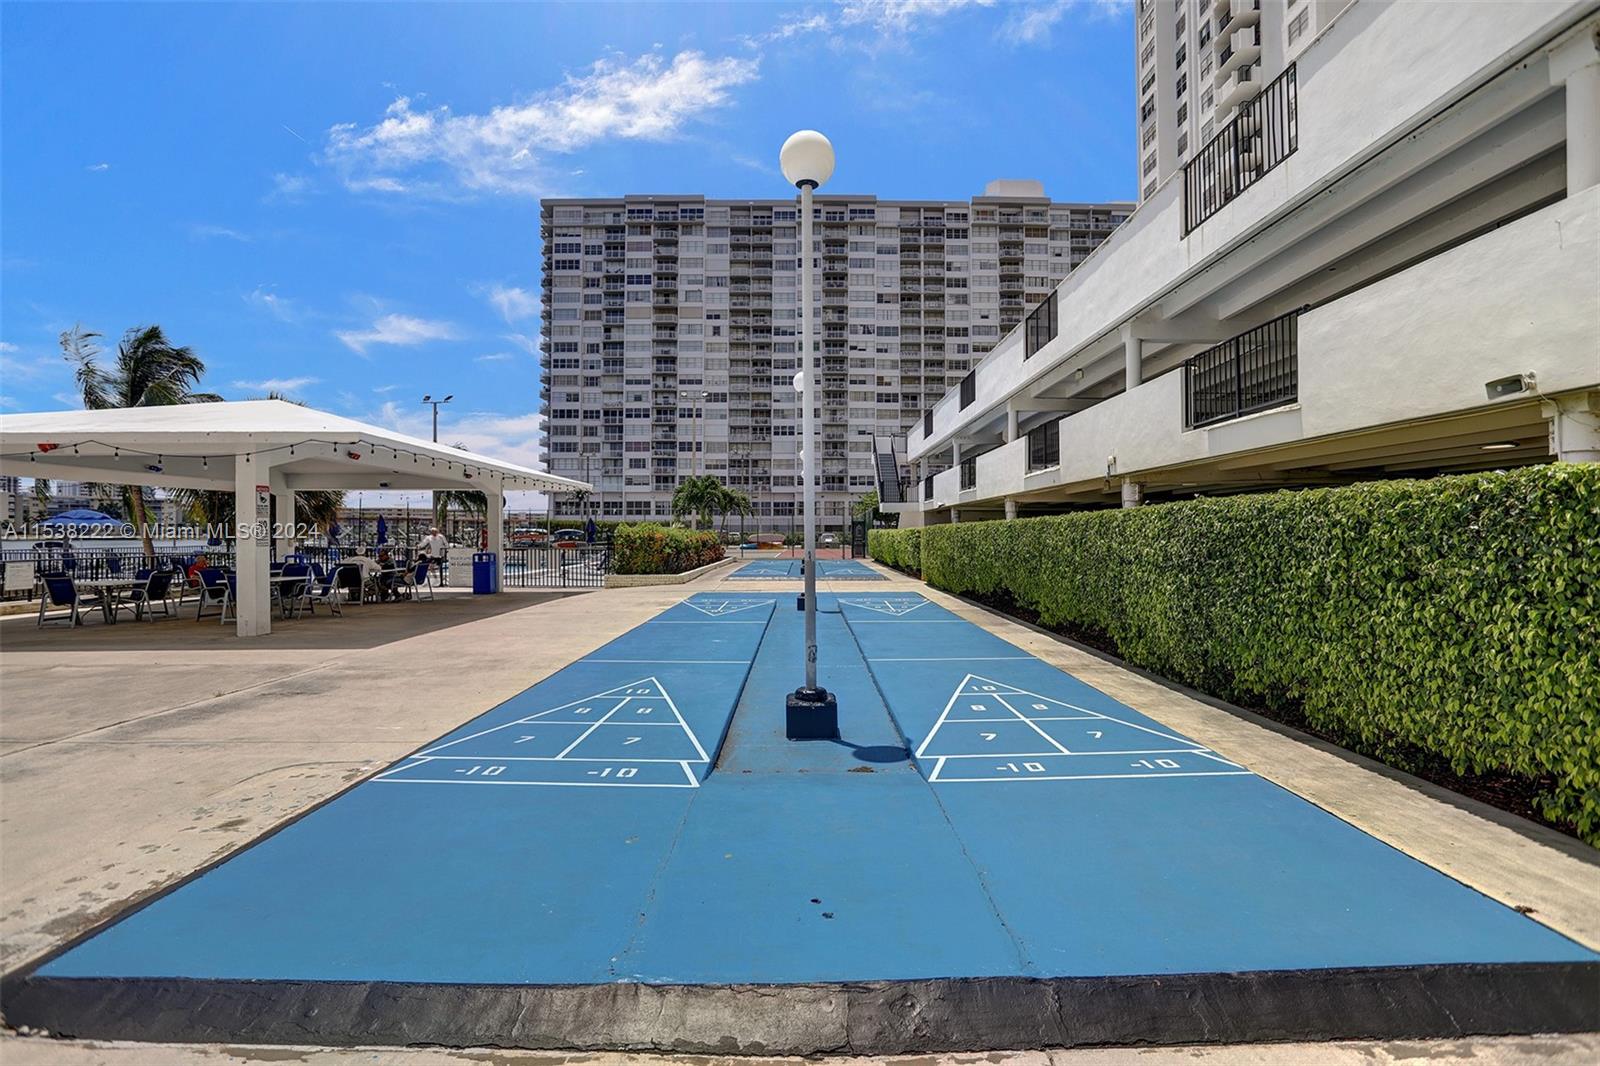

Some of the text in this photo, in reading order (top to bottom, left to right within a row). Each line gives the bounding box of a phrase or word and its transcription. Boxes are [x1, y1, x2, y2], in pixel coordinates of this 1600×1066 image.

[513, 735, 535, 743] 7
[980, 732, 997, 741] 7
[1086, 731, 1103, 739] 7
[622, 737, 642, 745] 7
[996, 762, 1046, 773] -10
[1130, 759, 1181, 769] -10
[454, 766, 508, 776] -10
[587, 767, 639, 778] -10
